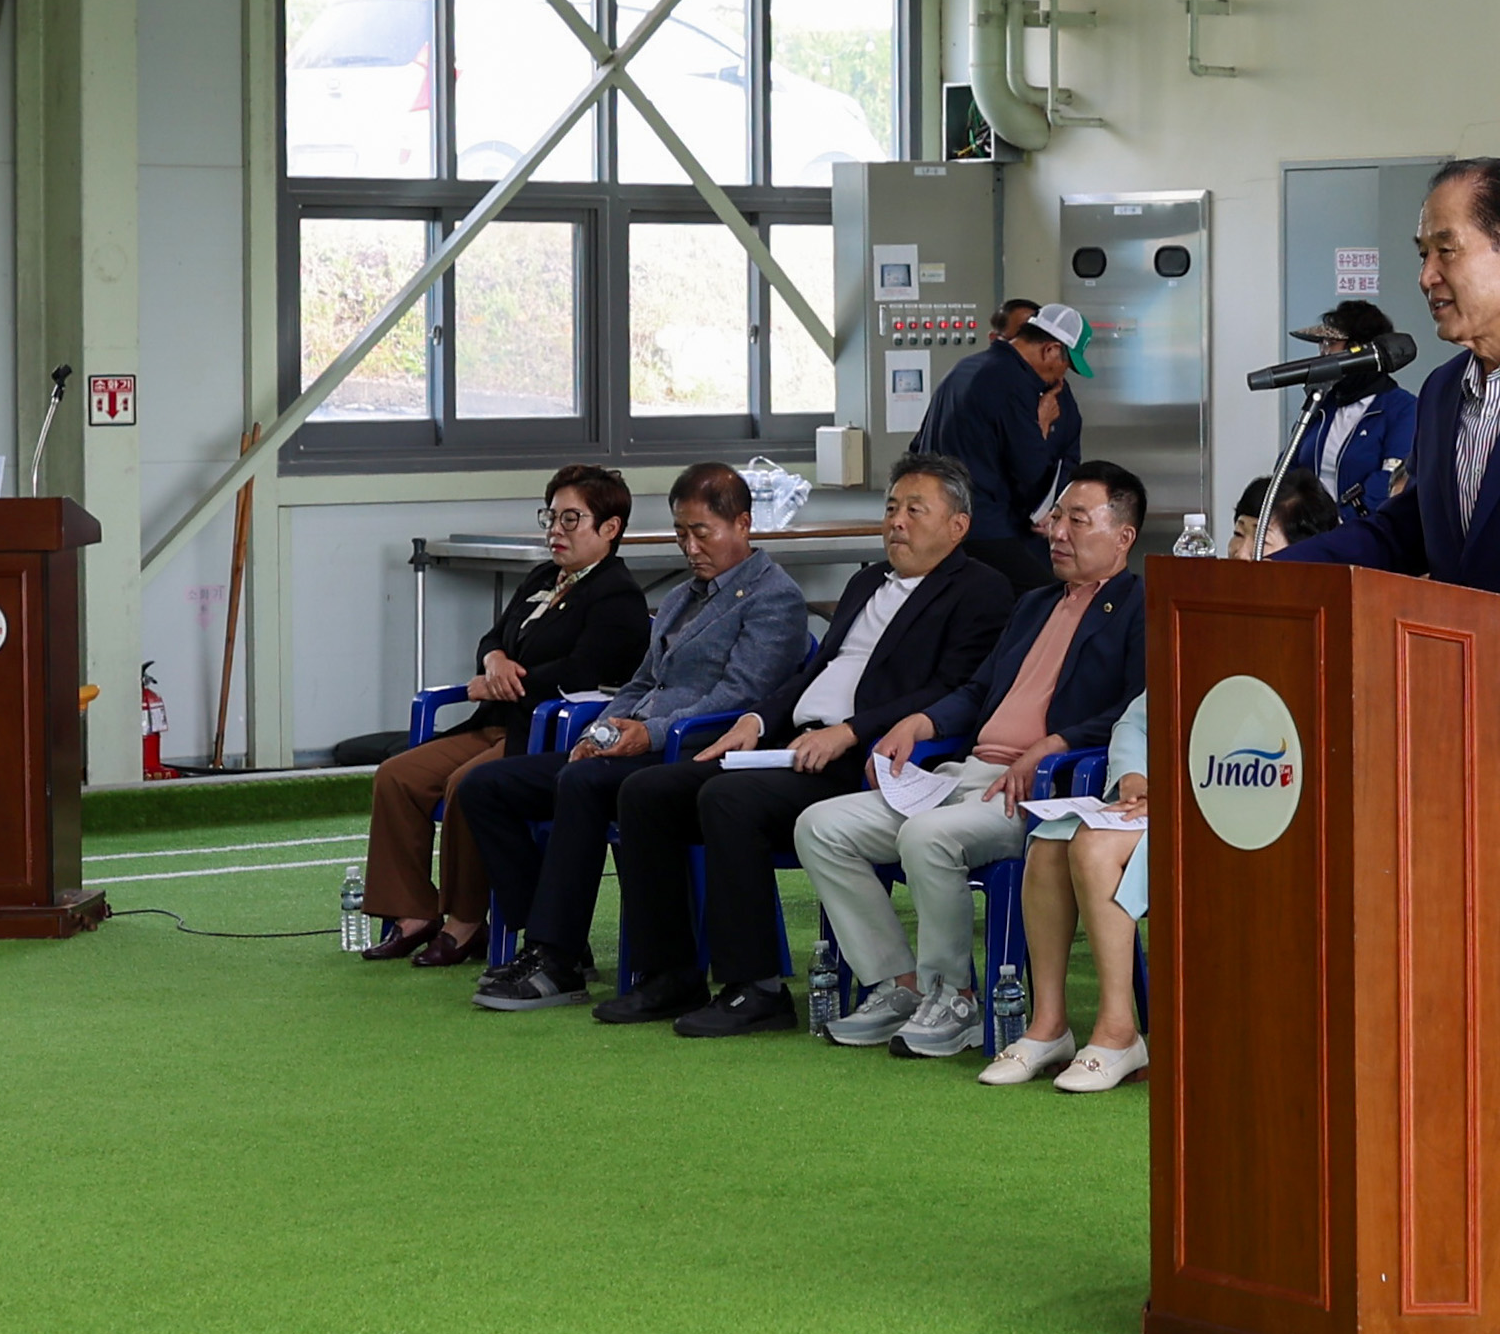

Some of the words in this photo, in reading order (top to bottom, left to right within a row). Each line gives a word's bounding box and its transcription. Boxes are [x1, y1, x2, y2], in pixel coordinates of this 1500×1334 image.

[1338, 276, 1356, 291] 소방
[94, 379, 132, 392] 소화기
[1199, 753, 1277, 789] Jindo
